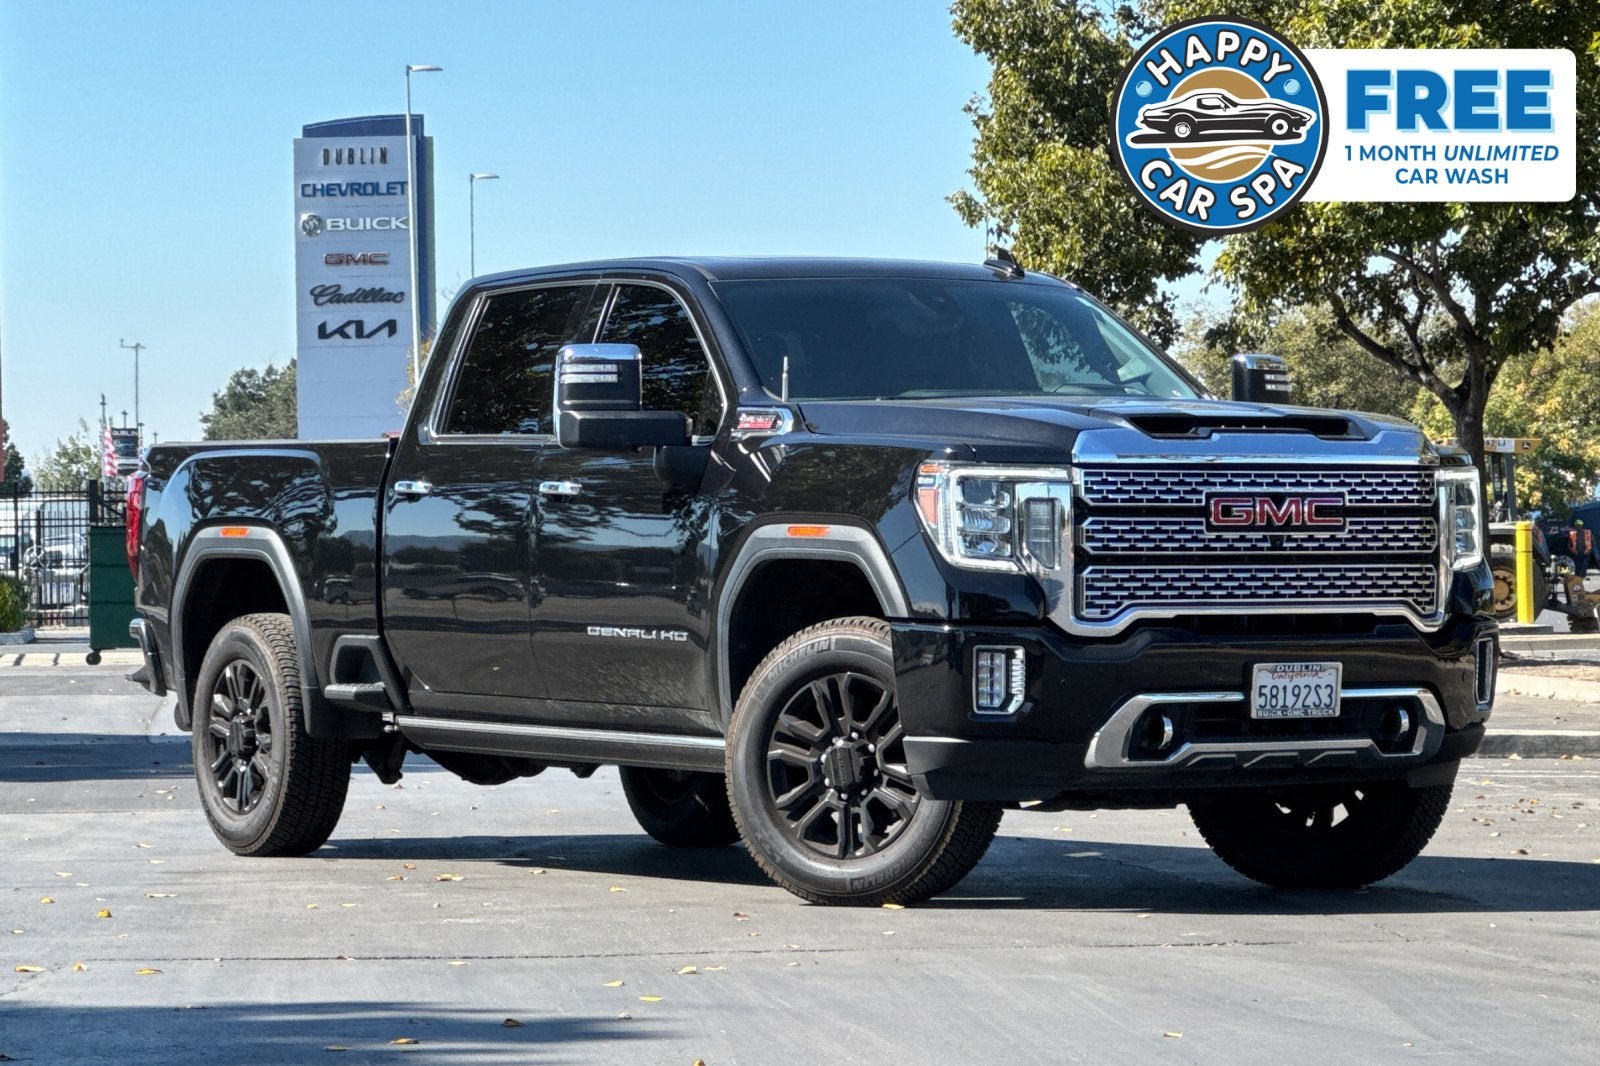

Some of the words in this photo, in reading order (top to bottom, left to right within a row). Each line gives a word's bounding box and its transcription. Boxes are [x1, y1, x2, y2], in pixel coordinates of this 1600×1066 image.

[323, 147, 387, 166] DUBLIN
[301, 181, 408, 198] CHEVROLET
[326, 216, 409, 231] BUICK
[324, 252, 389, 265] GMC
[309, 284, 405, 306] Cadillac
[317, 319, 397, 340] KIA
[1210, 497, 1344, 525] GMC
[587, 626, 657, 639] DENALI
[660, 630, 689, 641] HD
[767, 639, 830, 680] MICHELIN
[1276, 664, 1321, 672] DUBLIN
[1258, 684, 1334, 708] 58192S3
